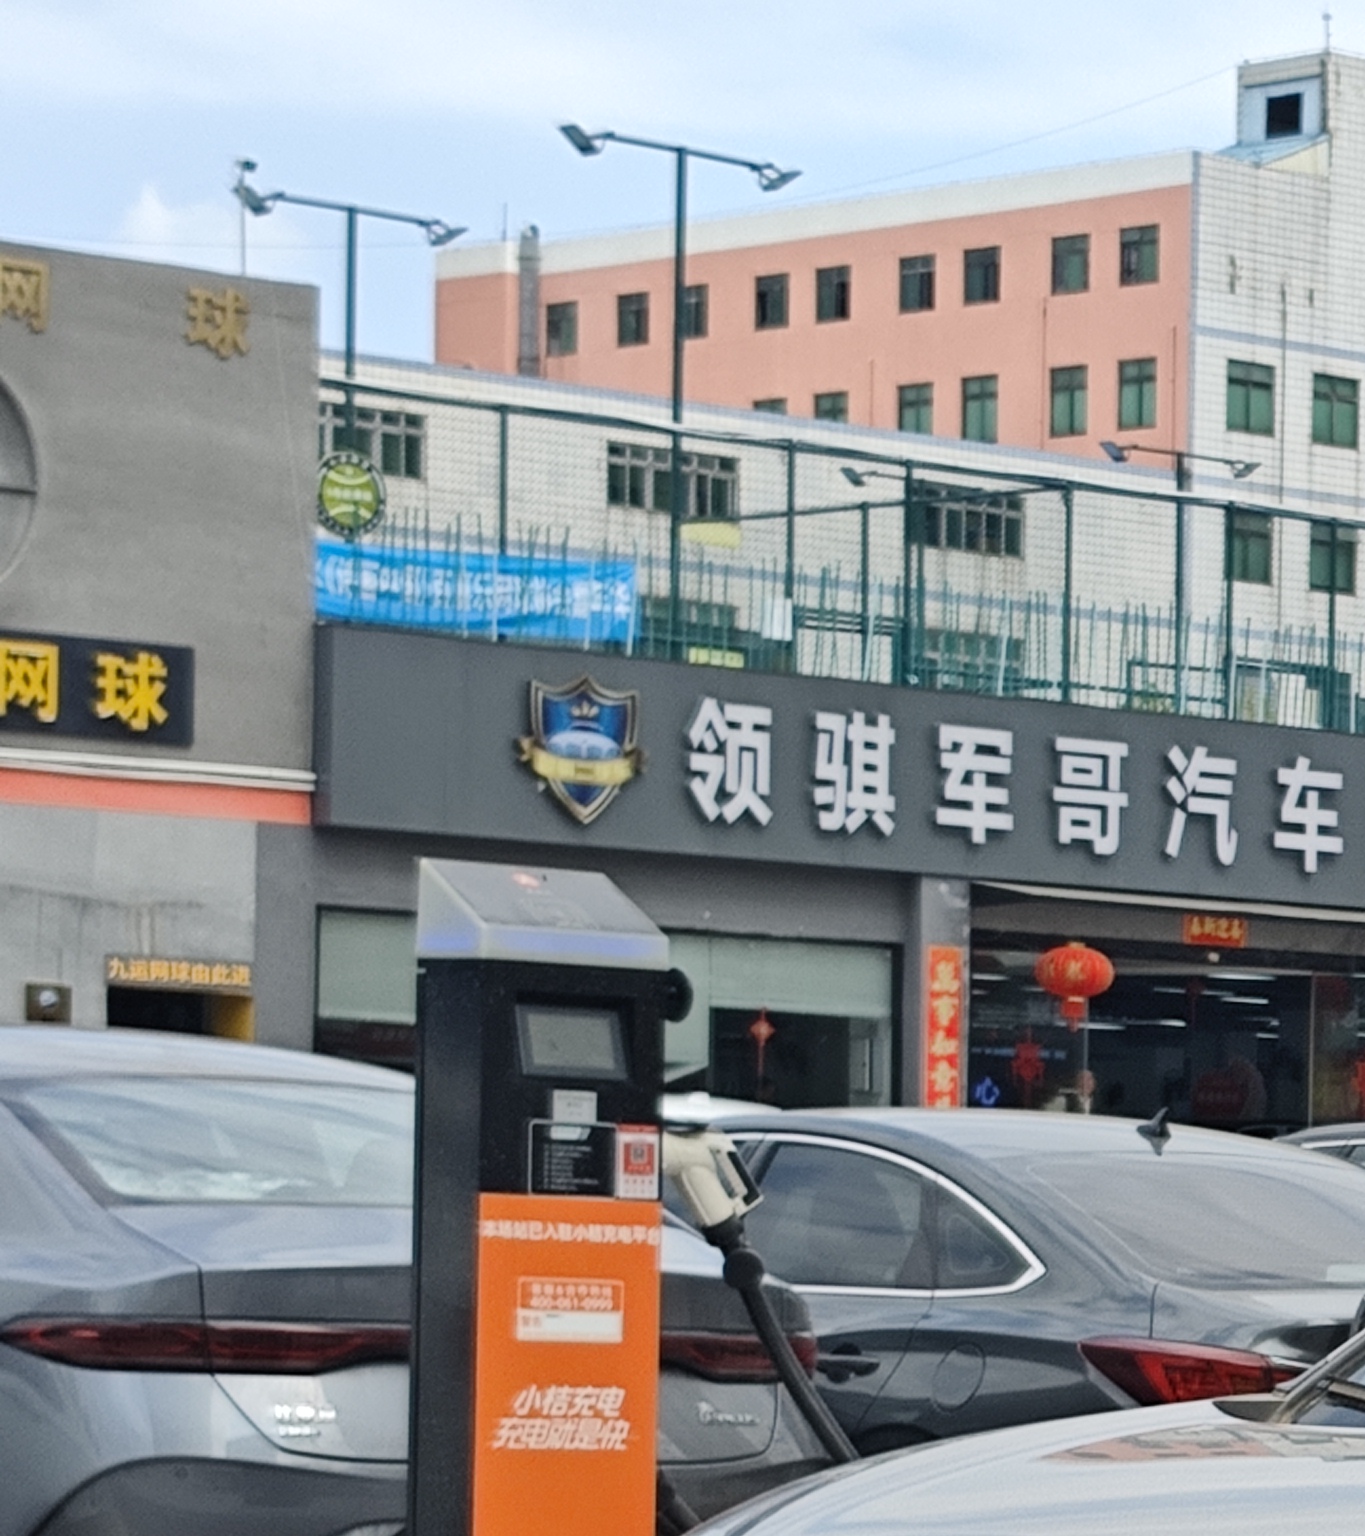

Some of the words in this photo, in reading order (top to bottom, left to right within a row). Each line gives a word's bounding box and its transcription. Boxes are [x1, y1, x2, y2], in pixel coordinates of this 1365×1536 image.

[0, 639, 169, 731] 网球
[513, 1383, 626, 1418] 小桔充电
[492, 1416, 631, 1450] 充电就是快
